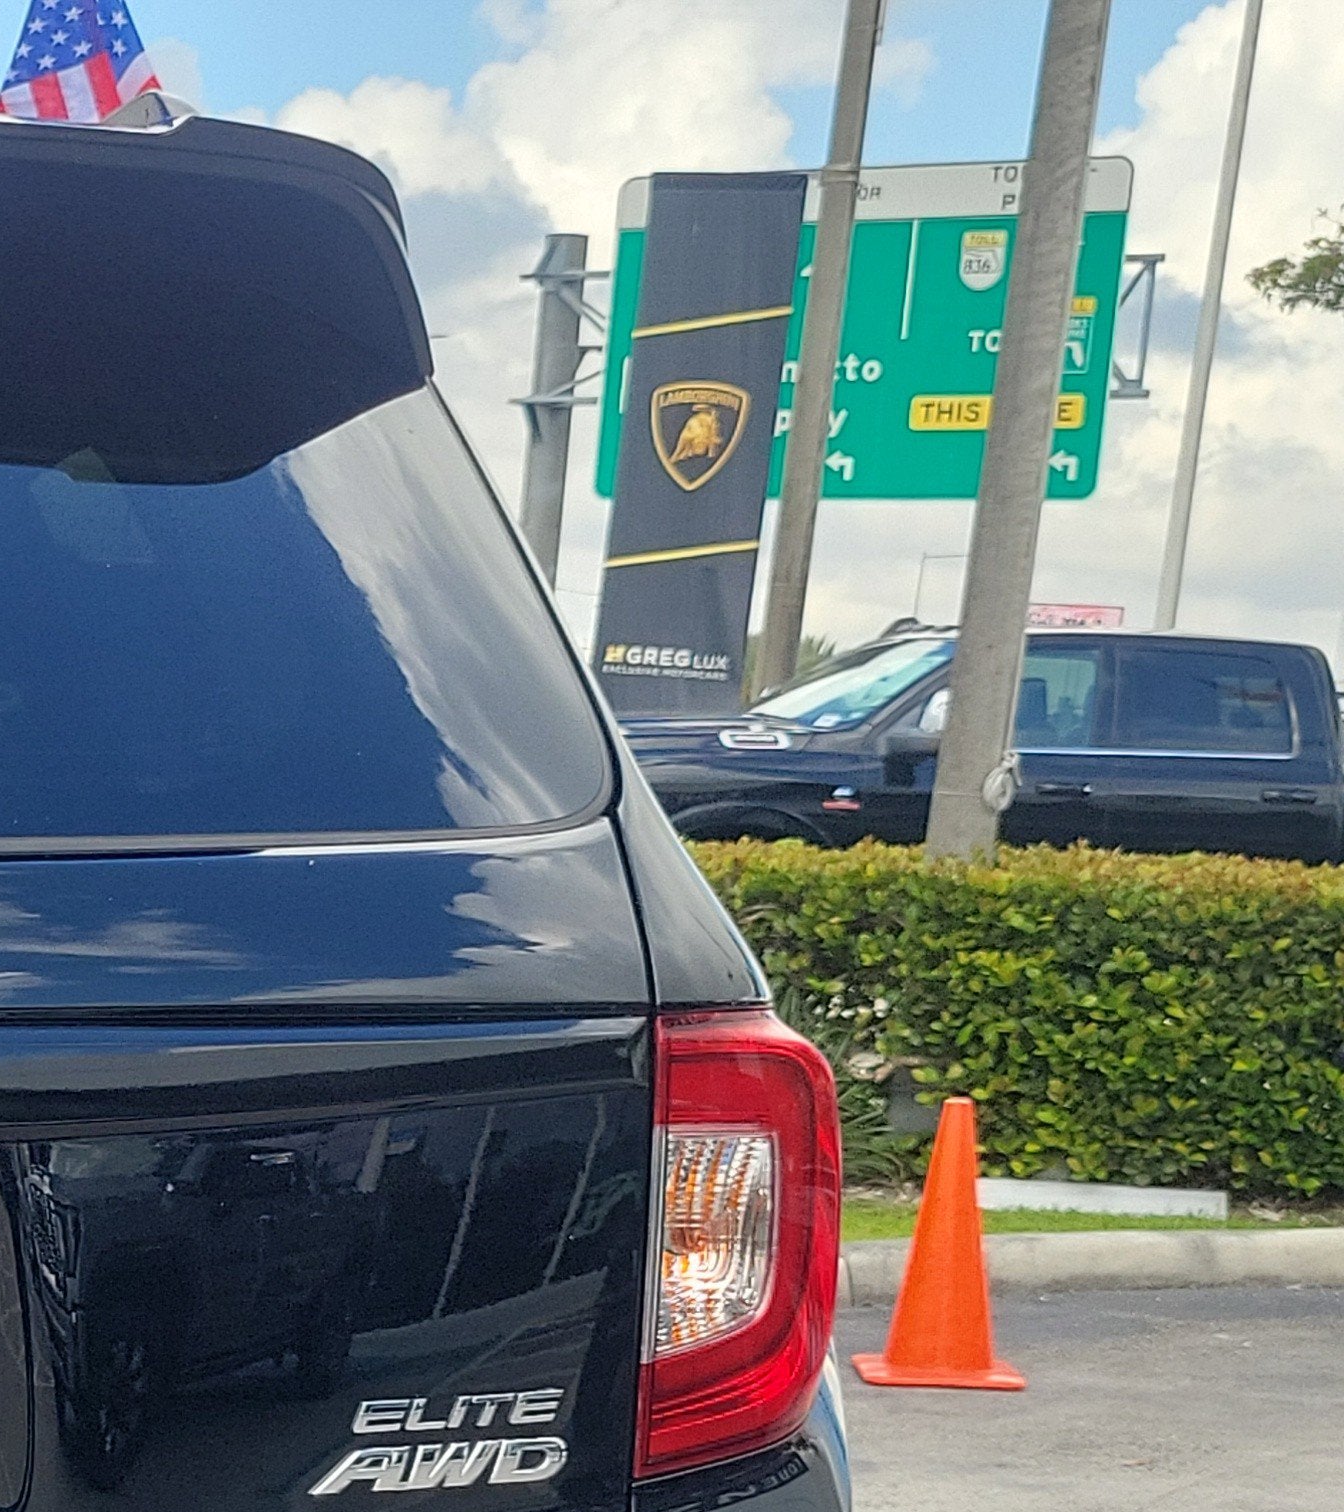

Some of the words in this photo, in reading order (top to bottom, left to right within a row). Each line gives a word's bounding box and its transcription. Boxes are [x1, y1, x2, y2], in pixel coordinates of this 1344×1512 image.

[919, 403, 982, 424] THIS
[692, 653, 728, 670] LUX
[352, 1388, 565, 1434] ELITE
[307, 1436, 568, 1496] AWD
